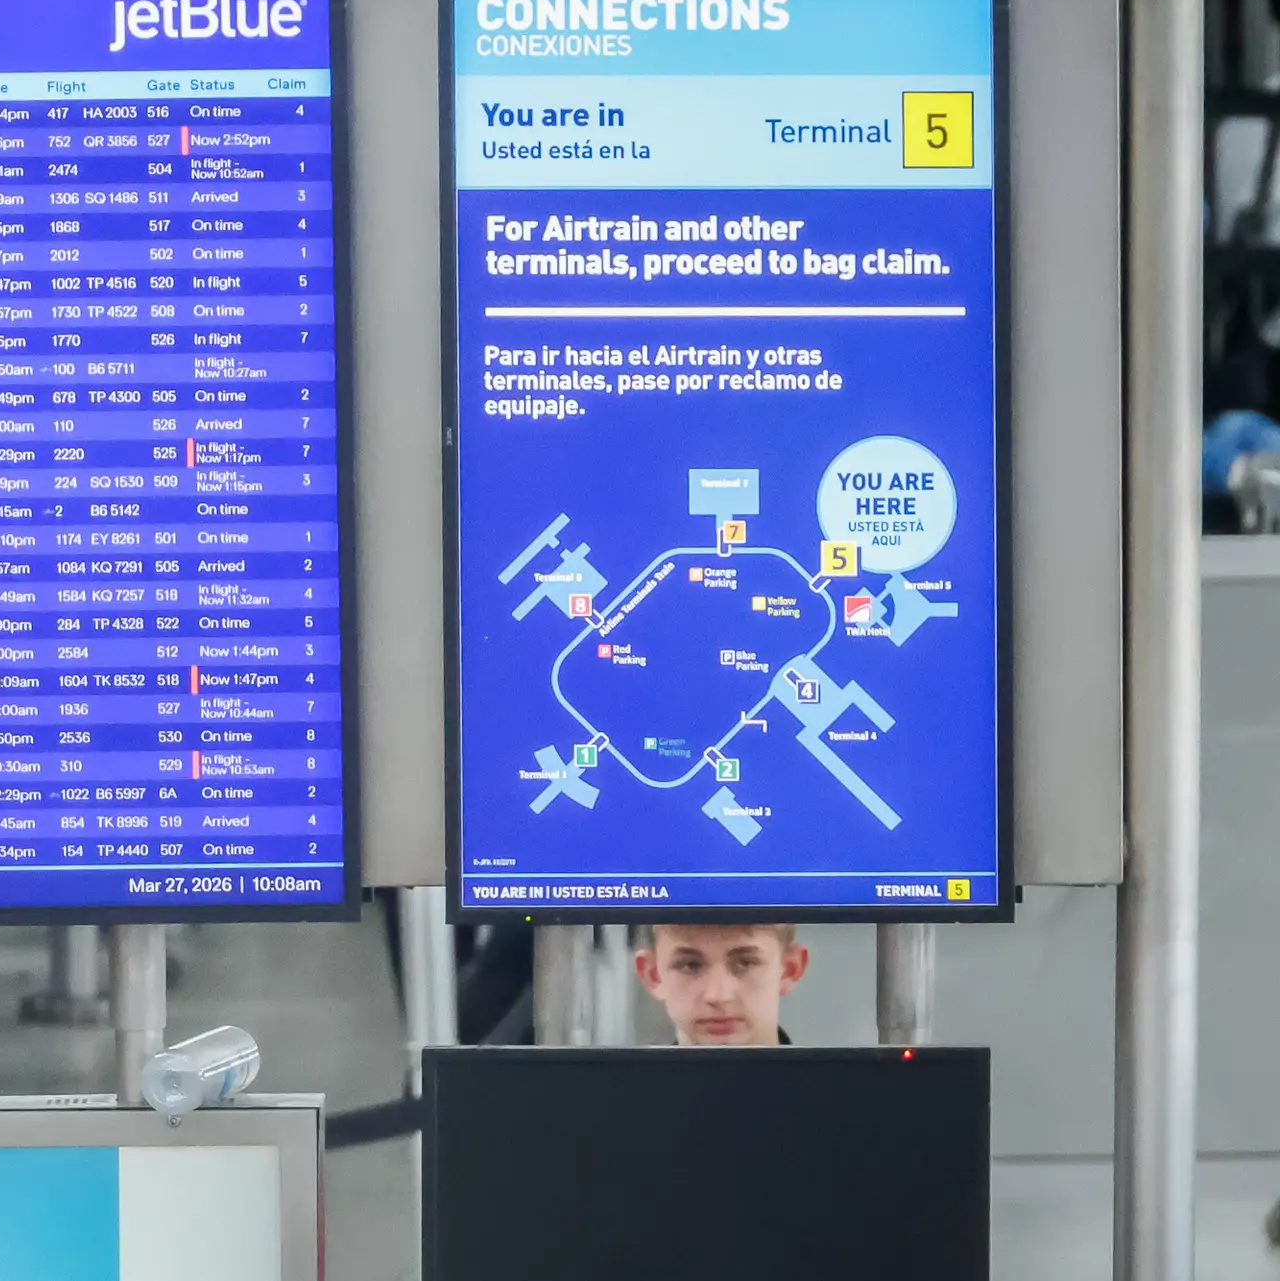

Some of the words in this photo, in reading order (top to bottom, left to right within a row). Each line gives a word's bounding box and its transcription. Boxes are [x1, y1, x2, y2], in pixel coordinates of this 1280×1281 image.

[477, 34, 632, 56] CONEXIONES
[47, 81, 86, 95] Flight
[147, 79, 180, 91] Gate
[190, 79, 235, 91] Status
[267, 78, 306, 90] Claim
[47, 107, 69, 119] 417
[83, 107, 104, 118] HA
[105, 106, 137, 118] 2003
[147, 106, 169, 118] 516
[190, 105, 210, 117] On
[213, 106, 241, 117] time
[296, 104, 304, 116] 4
[481, 103, 533, 127] You
[542, 108, 589, 127] are
[599, 102, 624, 126] in
[765, 118, 892, 143] Terminal
[926, 113, 948, 150] 5
[482, 141, 542, 159] Usted
[549, 139, 593, 159] está
[599, 145, 624, 159] en
[632, 141, 650, 159] la
[487, 215, 538, 241] For
[542, 215, 658, 241] Airtrain
[664, 215, 718, 241] and
[724, 215, 804, 241] other
[486, 248, 637, 280] terminals,
[644, 248, 762, 280] proceed
[768, 250, 798, 275] to
[804, 248, 856, 280] bag
[862, 248, 950, 274] claim.
[52, 334, 81, 347] 1770
[151, 333, 175, 346] 526
[194, 333, 206, 345] In
[208, 332, 242, 348] flight
[301, 332, 308, 343] 7
[484, 345, 536, 366] Para
[542, 345, 560, 366] ir
[565, 345, 623, 366] hacia
[628, 345, 650, 366] el
[654, 345, 741, 366] Airtrain
[746, 350, 760, 370] y
[764, 346, 822, 366] otras
[484, 370, 612, 393] terminales,
[618, 374, 670, 395] pase
[676, 374, 714, 395] por
[719, 368, 810, 390] reclamo
[815, 370, 842, 390] de
[484, 394, 586, 420] equipaje.
[838, 473, 882, 490] YOU
[889, 473, 934, 490] ARE
[856, 498, 916, 514] HERE
[730, 526, 739, 539] 7
[848, 522, 888, 532] USTED
[872, 536, 900, 546] AQUI
[832, 548, 847, 570] 5
[704, 568, 736, 578] Orange
[704, 579, 737, 590] Parking
[575, 598, 586, 613] 8
[767, 596, 797, 606] Yellow
[768, 608, 800, 618] Parking
[613, 644, 631, 654] Red
[736, 651, 756, 660] Blue
[613, 656, 646, 666] Parking
[736, 662, 769, 673] Parking
[801, 683, 813, 698] 4
[828, 732, 868, 740] Terminal
[580, 748, 590, 764] 1
[722, 762, 733, 777] 2
[129, 878, 162, 893] Mar
[165, 878, 188, 894] 27,
[192, 877, 232, 892] 2026
[252, 876, 321, 891] 10:08am
[472, 886, 499, 898] YOU
[500, 886, 527, 898] ARE
[529, 886, 544, 898] IN
[552, 886, 594, 898] USTED
[597, 883, 629, 898] ESTÁ
[631, 886, 648, 898] EN
[651, 886, 669, 898] LA
[875, 884, 942, 897] TERMINAL
[955, 883, 964, 897] 5
